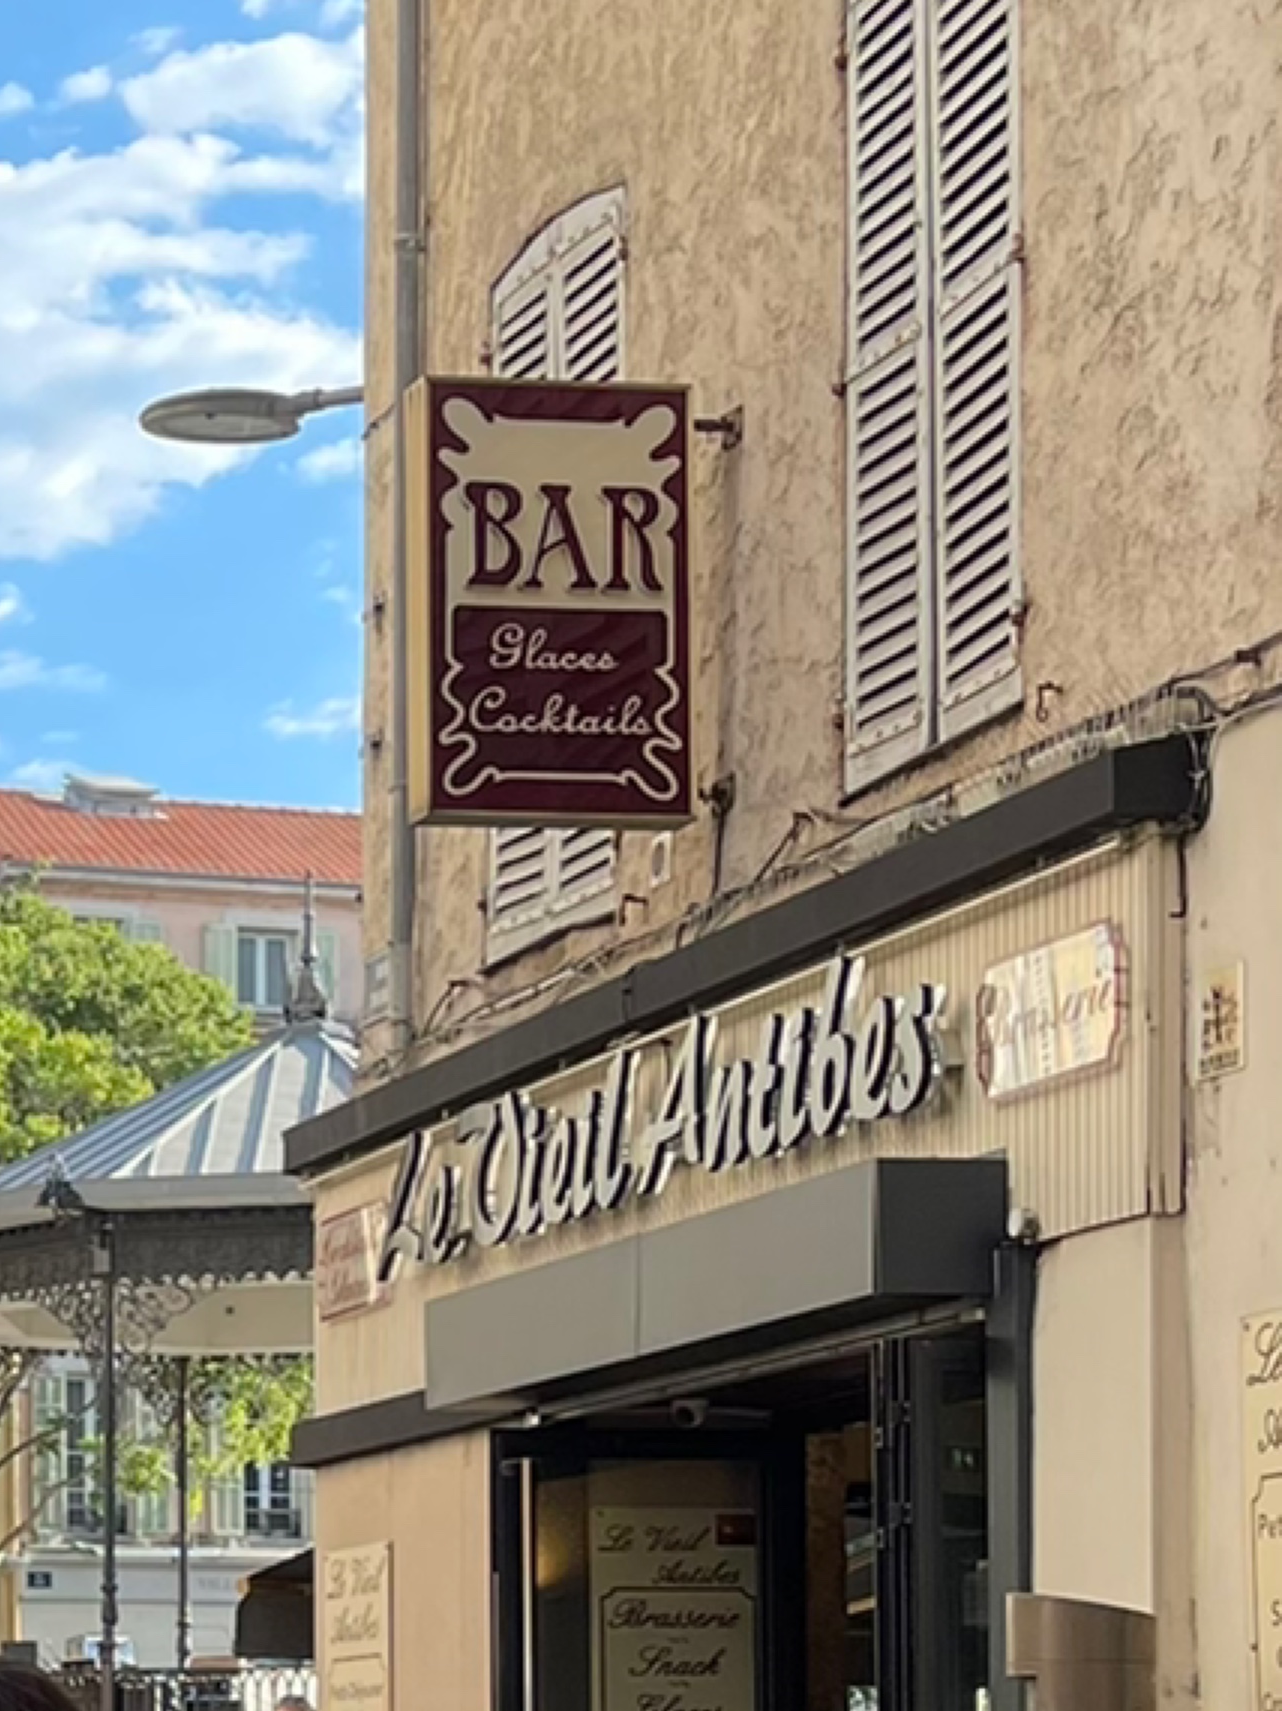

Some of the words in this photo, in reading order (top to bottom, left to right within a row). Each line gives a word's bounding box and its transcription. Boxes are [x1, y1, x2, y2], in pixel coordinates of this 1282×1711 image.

[466, 481, 663, 591] BAR
[488, 623, 619, 671] Glaces
[468, 686, 652, 736] Cocktails
[377, 1130, 467, 1281] Le
[459, 1050, 641, 1245] Vieil
[636, 956, 946, 1194] Antibes
[607, 1598, 740, 1629] Brasserie
[628, 1646, 726, 1677] Snack
